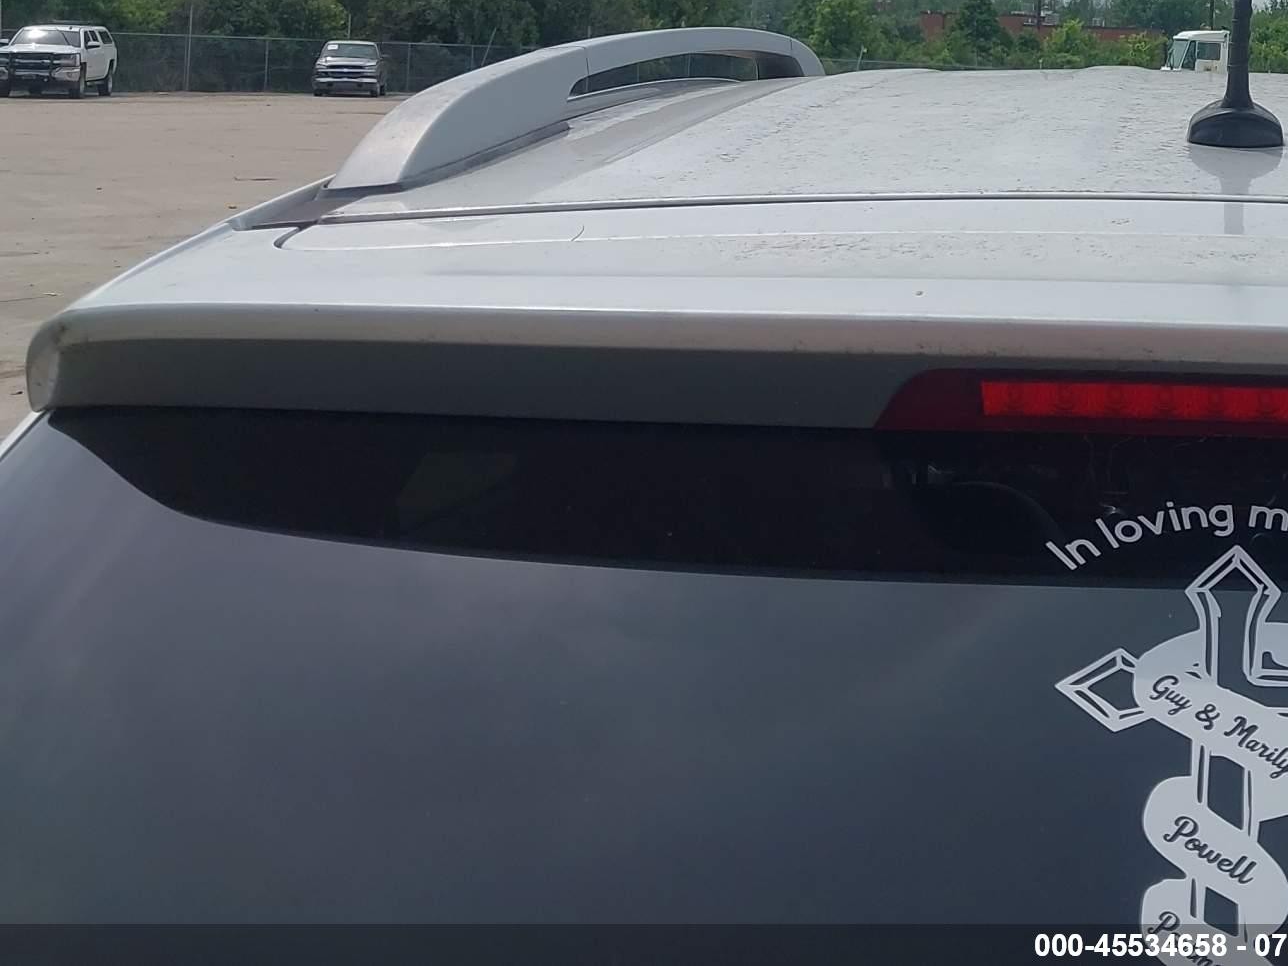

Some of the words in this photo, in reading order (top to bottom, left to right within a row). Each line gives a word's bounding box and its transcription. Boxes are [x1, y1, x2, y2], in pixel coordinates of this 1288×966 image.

[1045, 538, 1102, 571] In
[1095, 501, 1236, 549] loving
[1149, 675, 1193, 716] Guy
[1195, 703, 1221, 731] &
[1162, 815, 1257, 885] Powell
